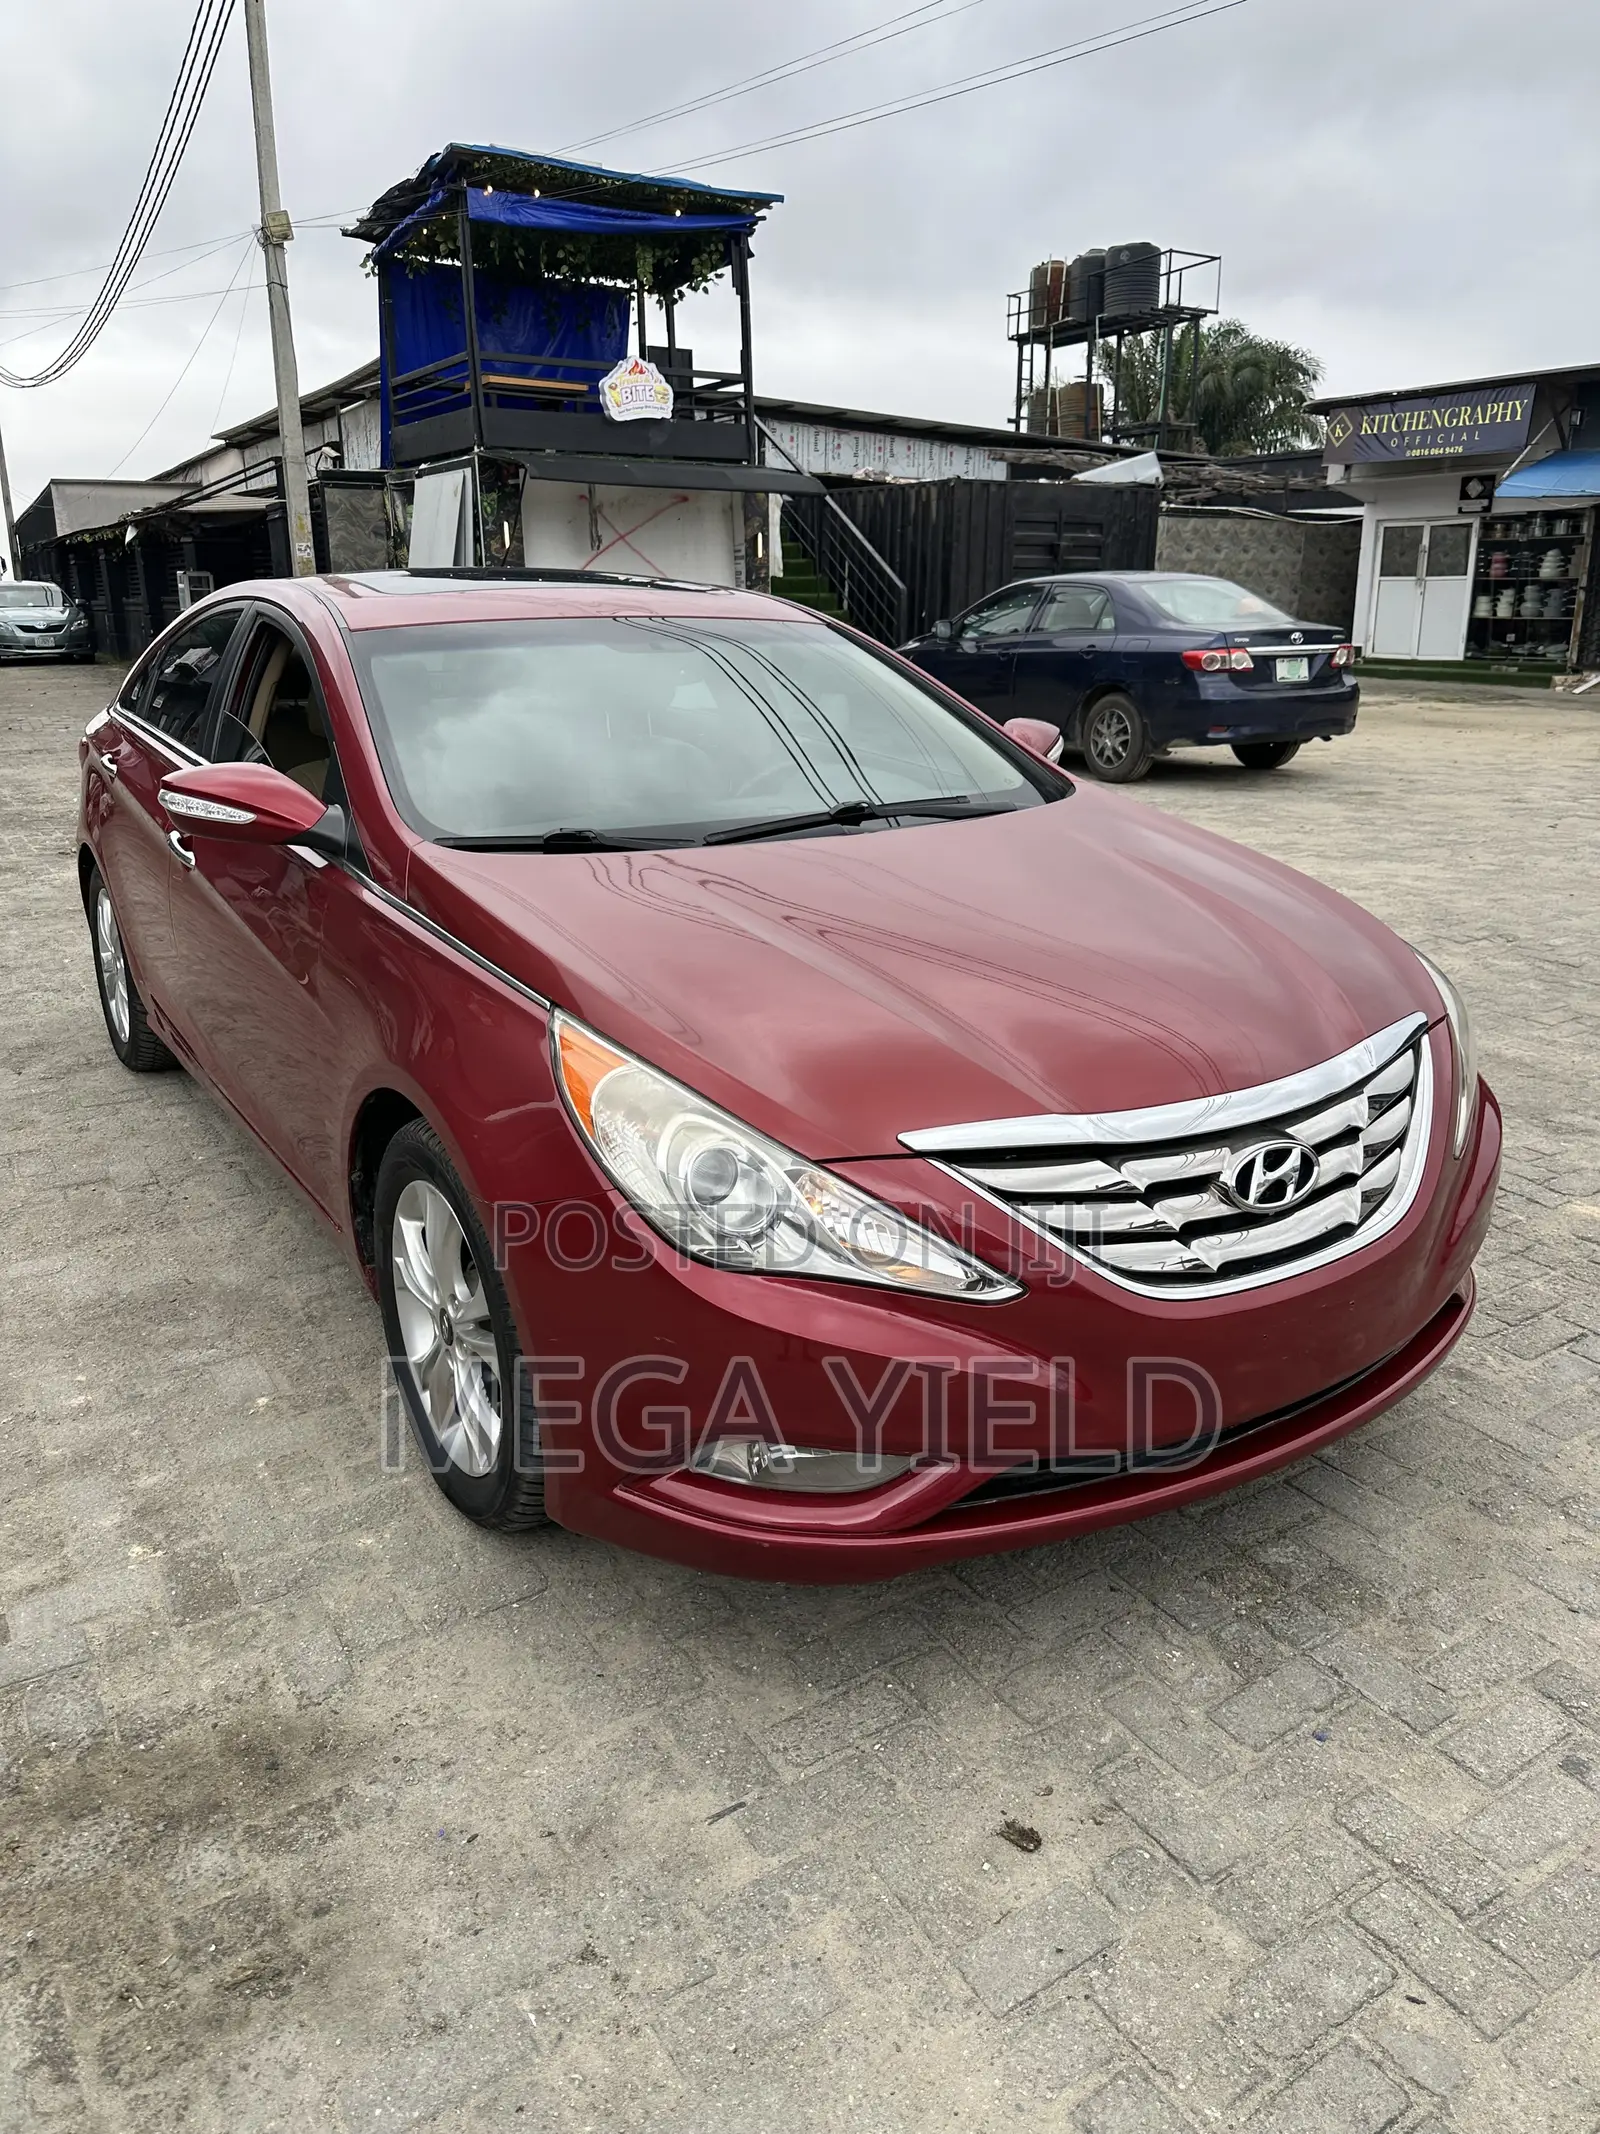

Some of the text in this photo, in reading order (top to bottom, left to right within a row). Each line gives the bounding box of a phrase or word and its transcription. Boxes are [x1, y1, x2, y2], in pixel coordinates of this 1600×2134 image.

[620, 384, 655, 405] BITE
[1360, 400, 1528, 435] KITCHENGRAPHY
[1334, 424, 1344, 438] K
[1391, 430, 1480, 447] OFFICIAL
